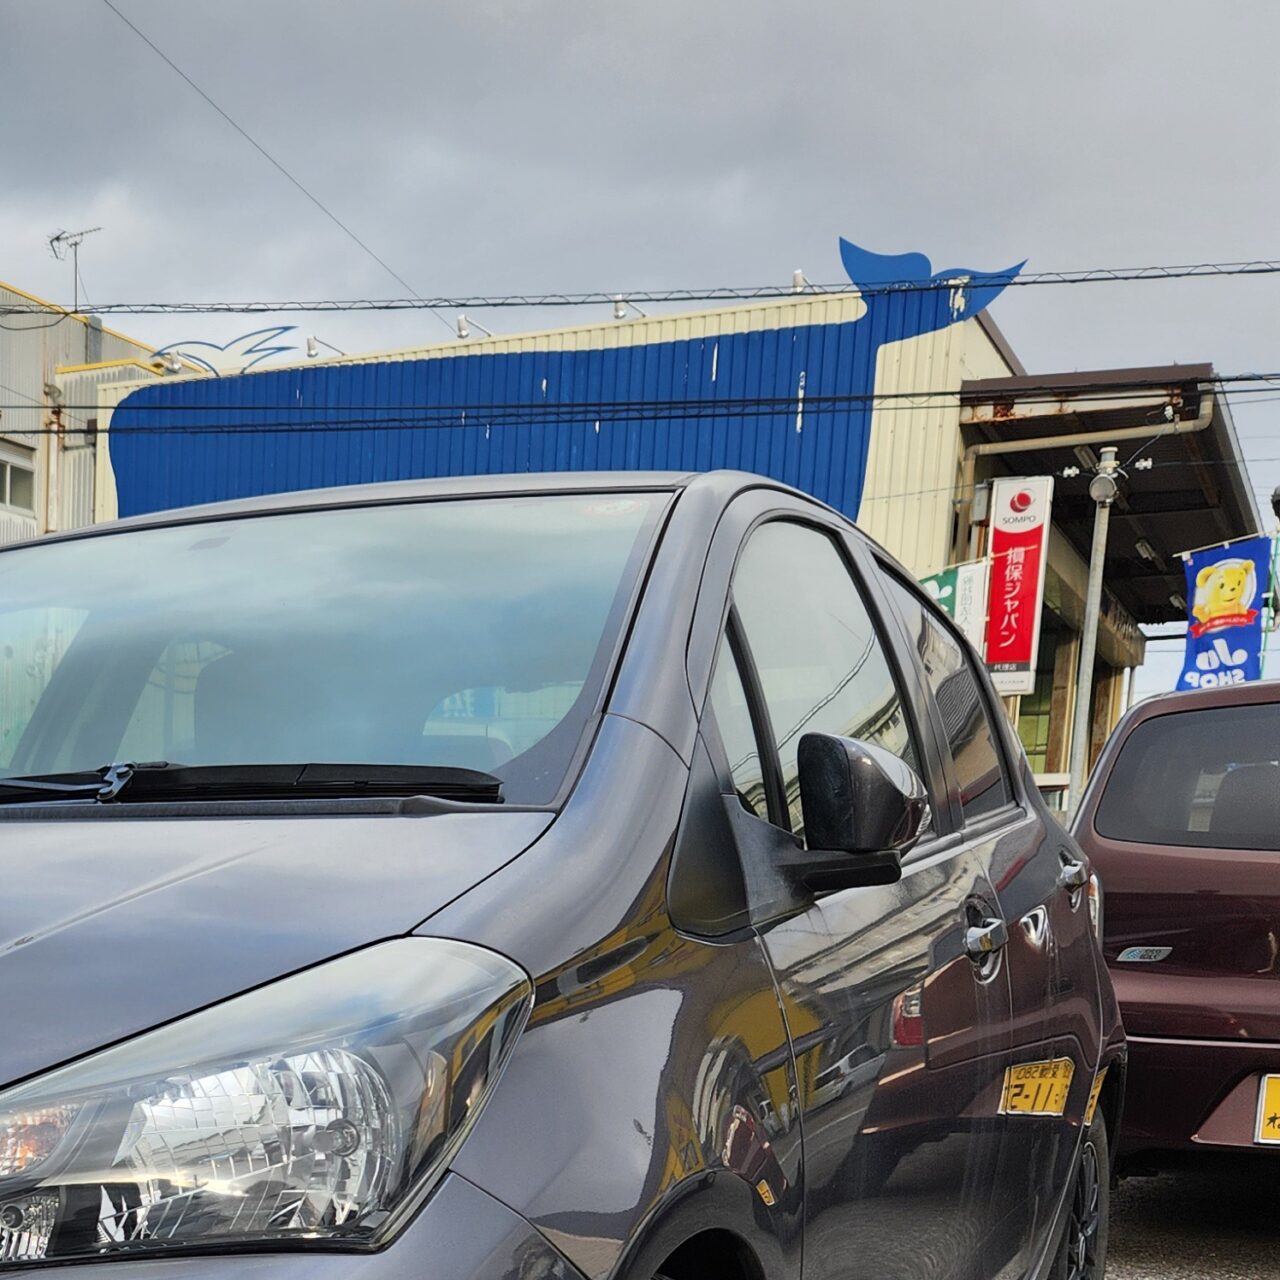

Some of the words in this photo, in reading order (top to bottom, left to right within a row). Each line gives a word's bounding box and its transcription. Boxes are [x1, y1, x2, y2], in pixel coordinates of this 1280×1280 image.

[1002, 515, 1037, 525] SOMPO
[1000, 547, 1025, 648] 損保ジャパン
